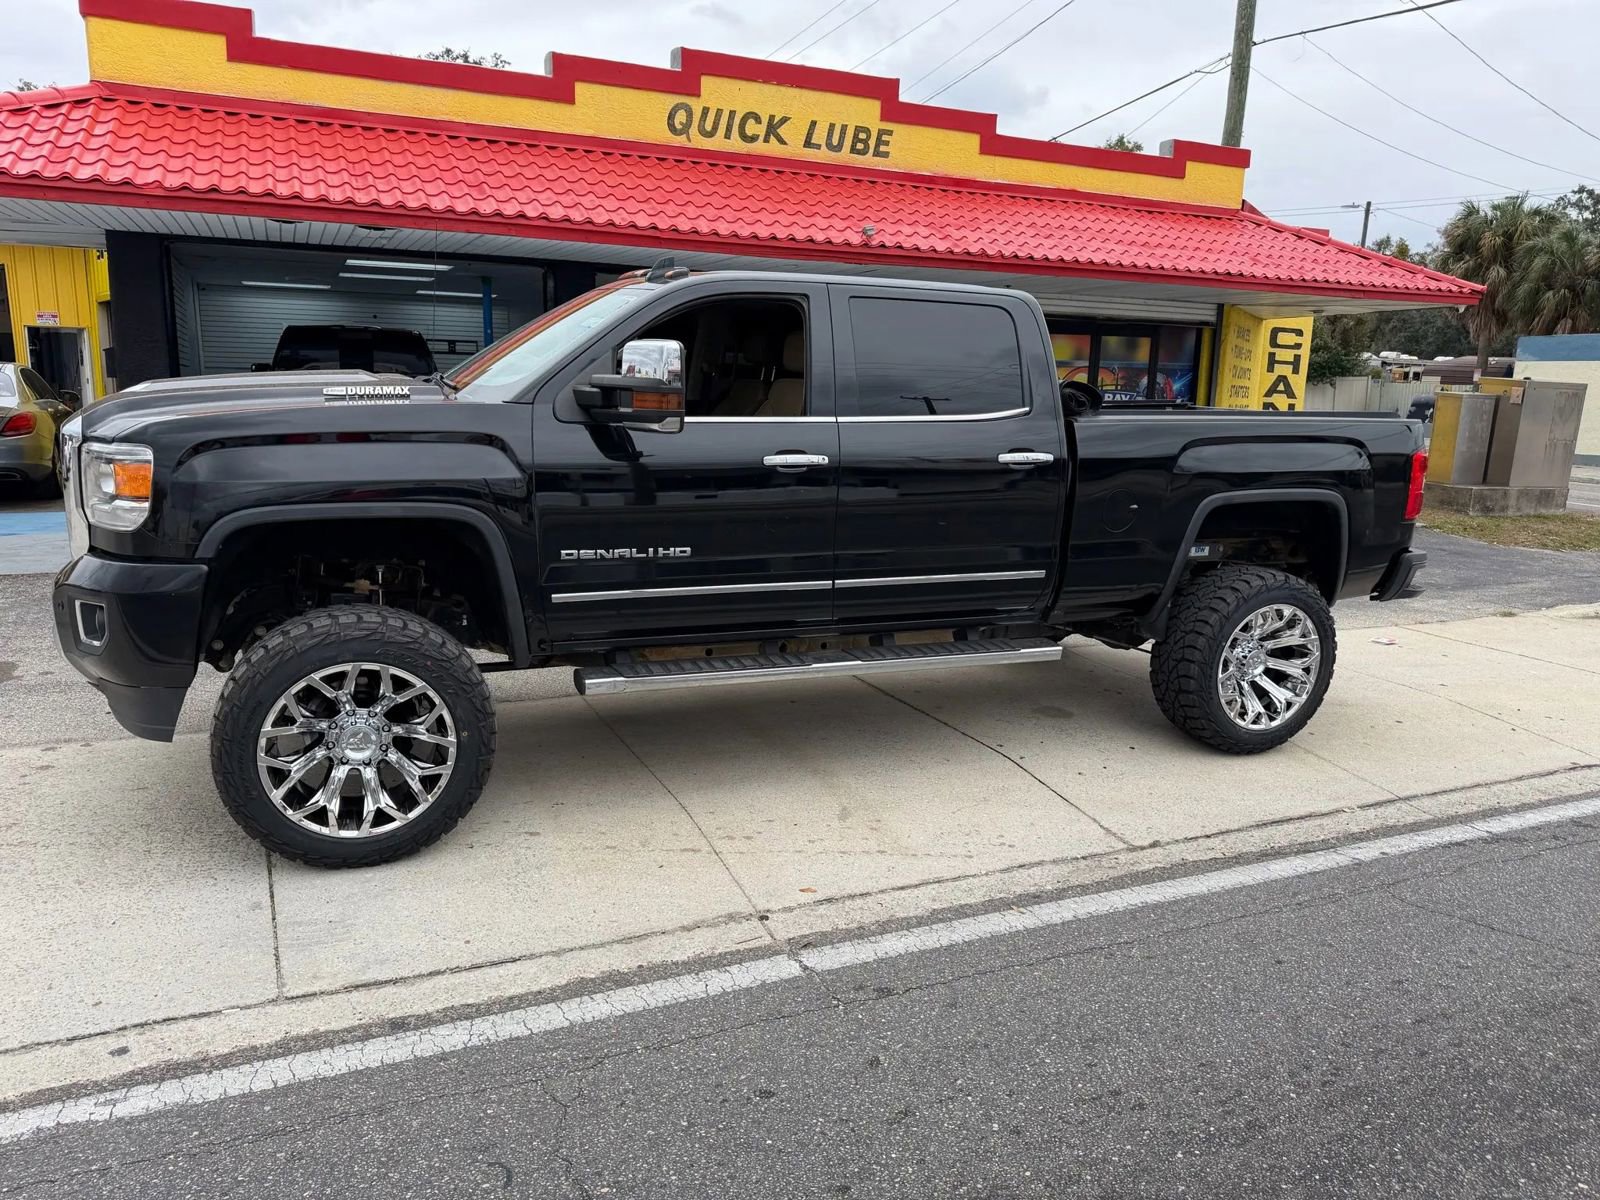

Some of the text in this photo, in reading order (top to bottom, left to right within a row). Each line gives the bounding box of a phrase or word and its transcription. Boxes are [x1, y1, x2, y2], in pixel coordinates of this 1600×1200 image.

[666, 102, 894, 159] QUICK LUBE
[347, 386, 410, 395] DURAMAX
[560, 547, 691, 560] DENALI HD
